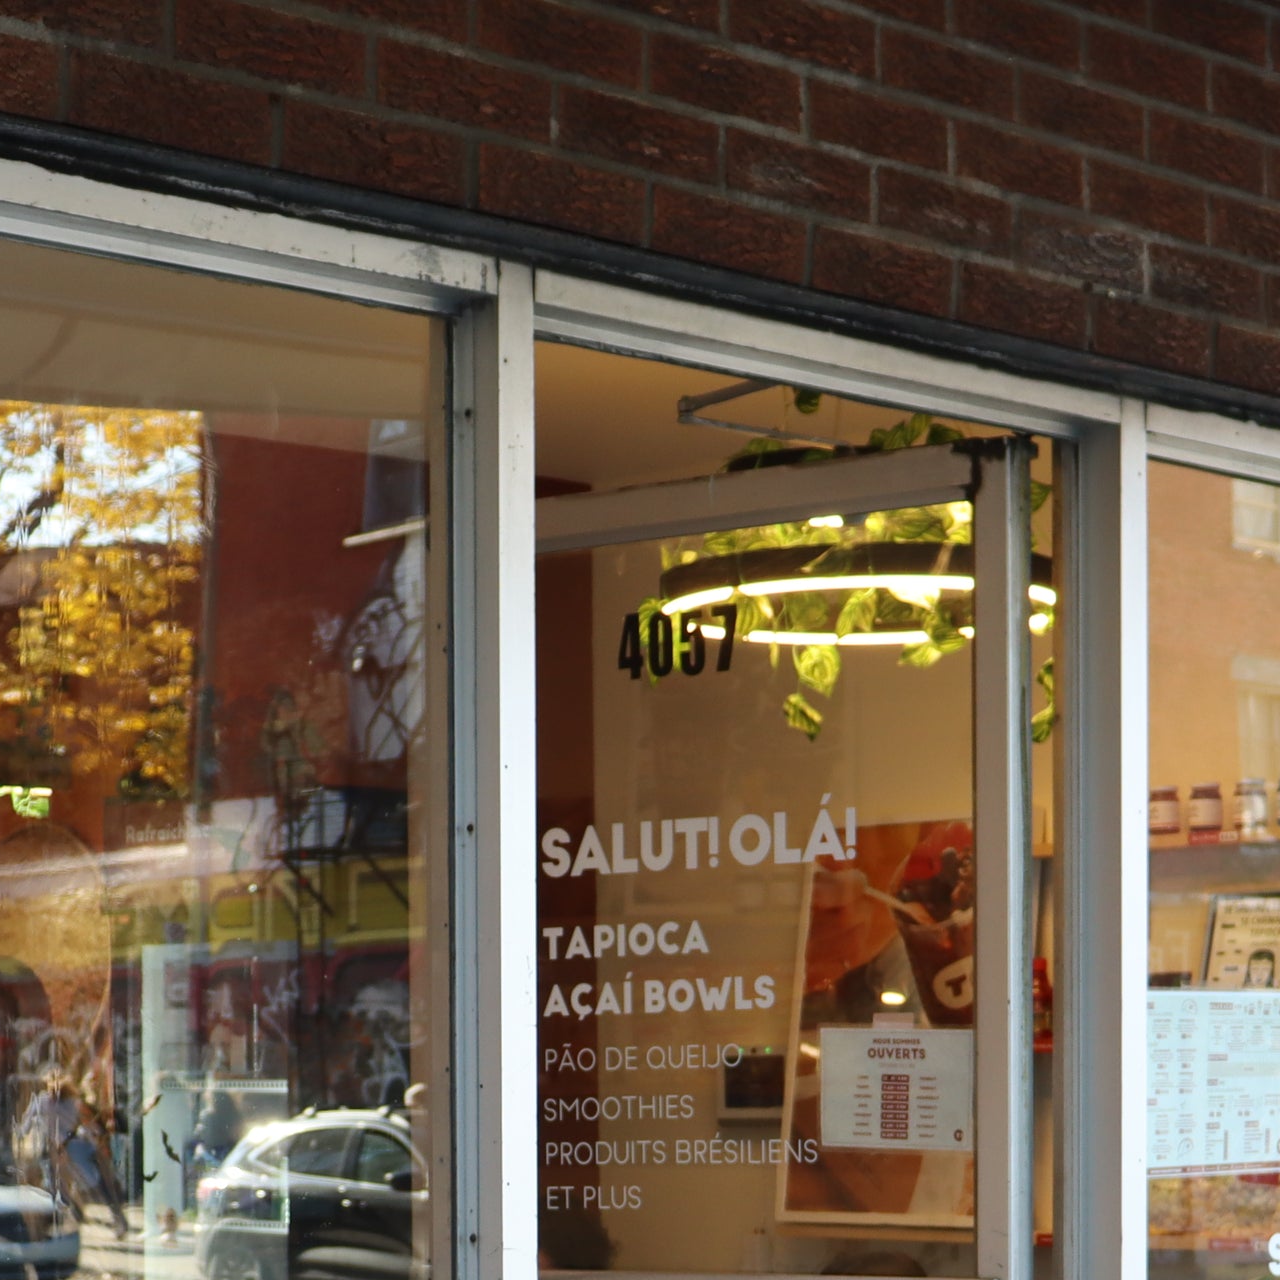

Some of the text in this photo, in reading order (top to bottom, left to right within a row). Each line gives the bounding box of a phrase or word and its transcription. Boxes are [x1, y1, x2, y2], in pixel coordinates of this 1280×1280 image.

[618, 604, 738, 680] 4057
[541, 793, 857, 878] SALUT! OLÁ!
[542, 920, 710, 960] TAPIOCA
[543, 973, 776, 1020] AÇAÍ BOWLS
[544, 1043, 744, 1072] PÃO DE QUEIJO
[867, 1048, 926, 1060] OUVERTS
[543, 1094, 695, 1122] SMOOTHIES
[545, 1131, 819, 1166] PRODUITS BRÉSILIENS
[546, 1185, 642, 1210] ET PLUS
